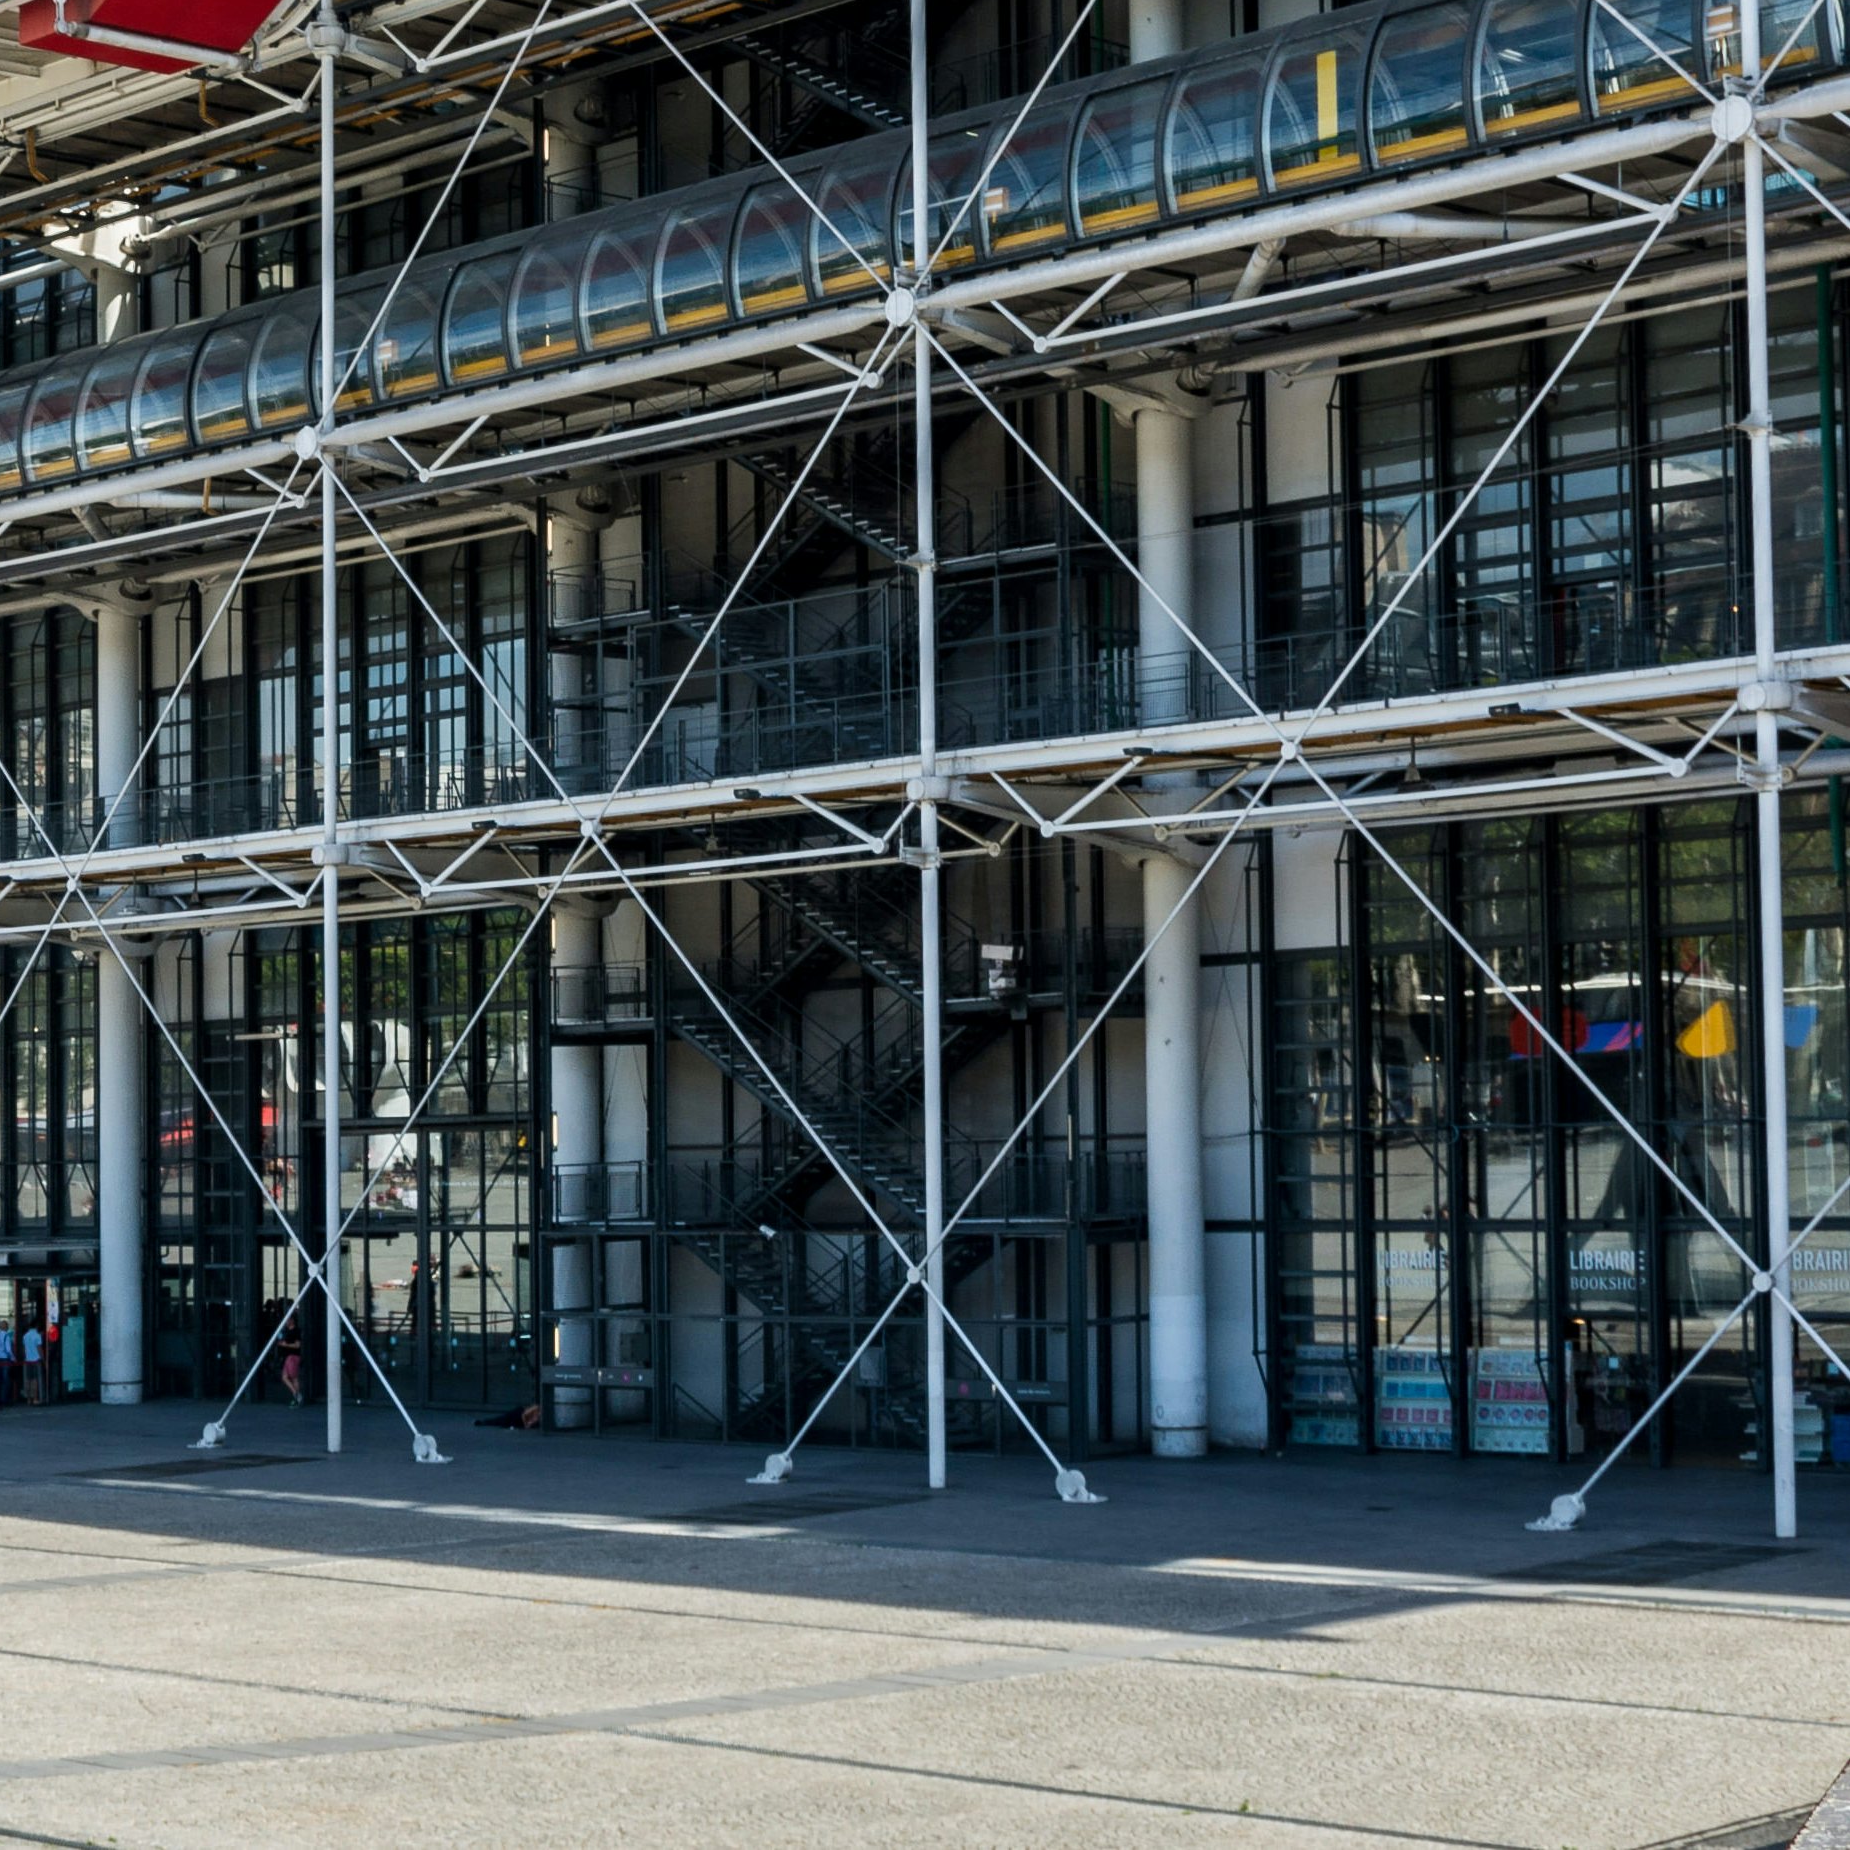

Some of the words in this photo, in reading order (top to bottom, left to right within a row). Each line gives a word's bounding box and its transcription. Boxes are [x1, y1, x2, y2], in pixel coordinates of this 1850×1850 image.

[1376, 1249, 1447, 1270] LIBRAIRIE
[1570, 1250, 1645, 1270] LIBRAIRIE
[1792, 1249, 1850, 1271] BRAIRI
